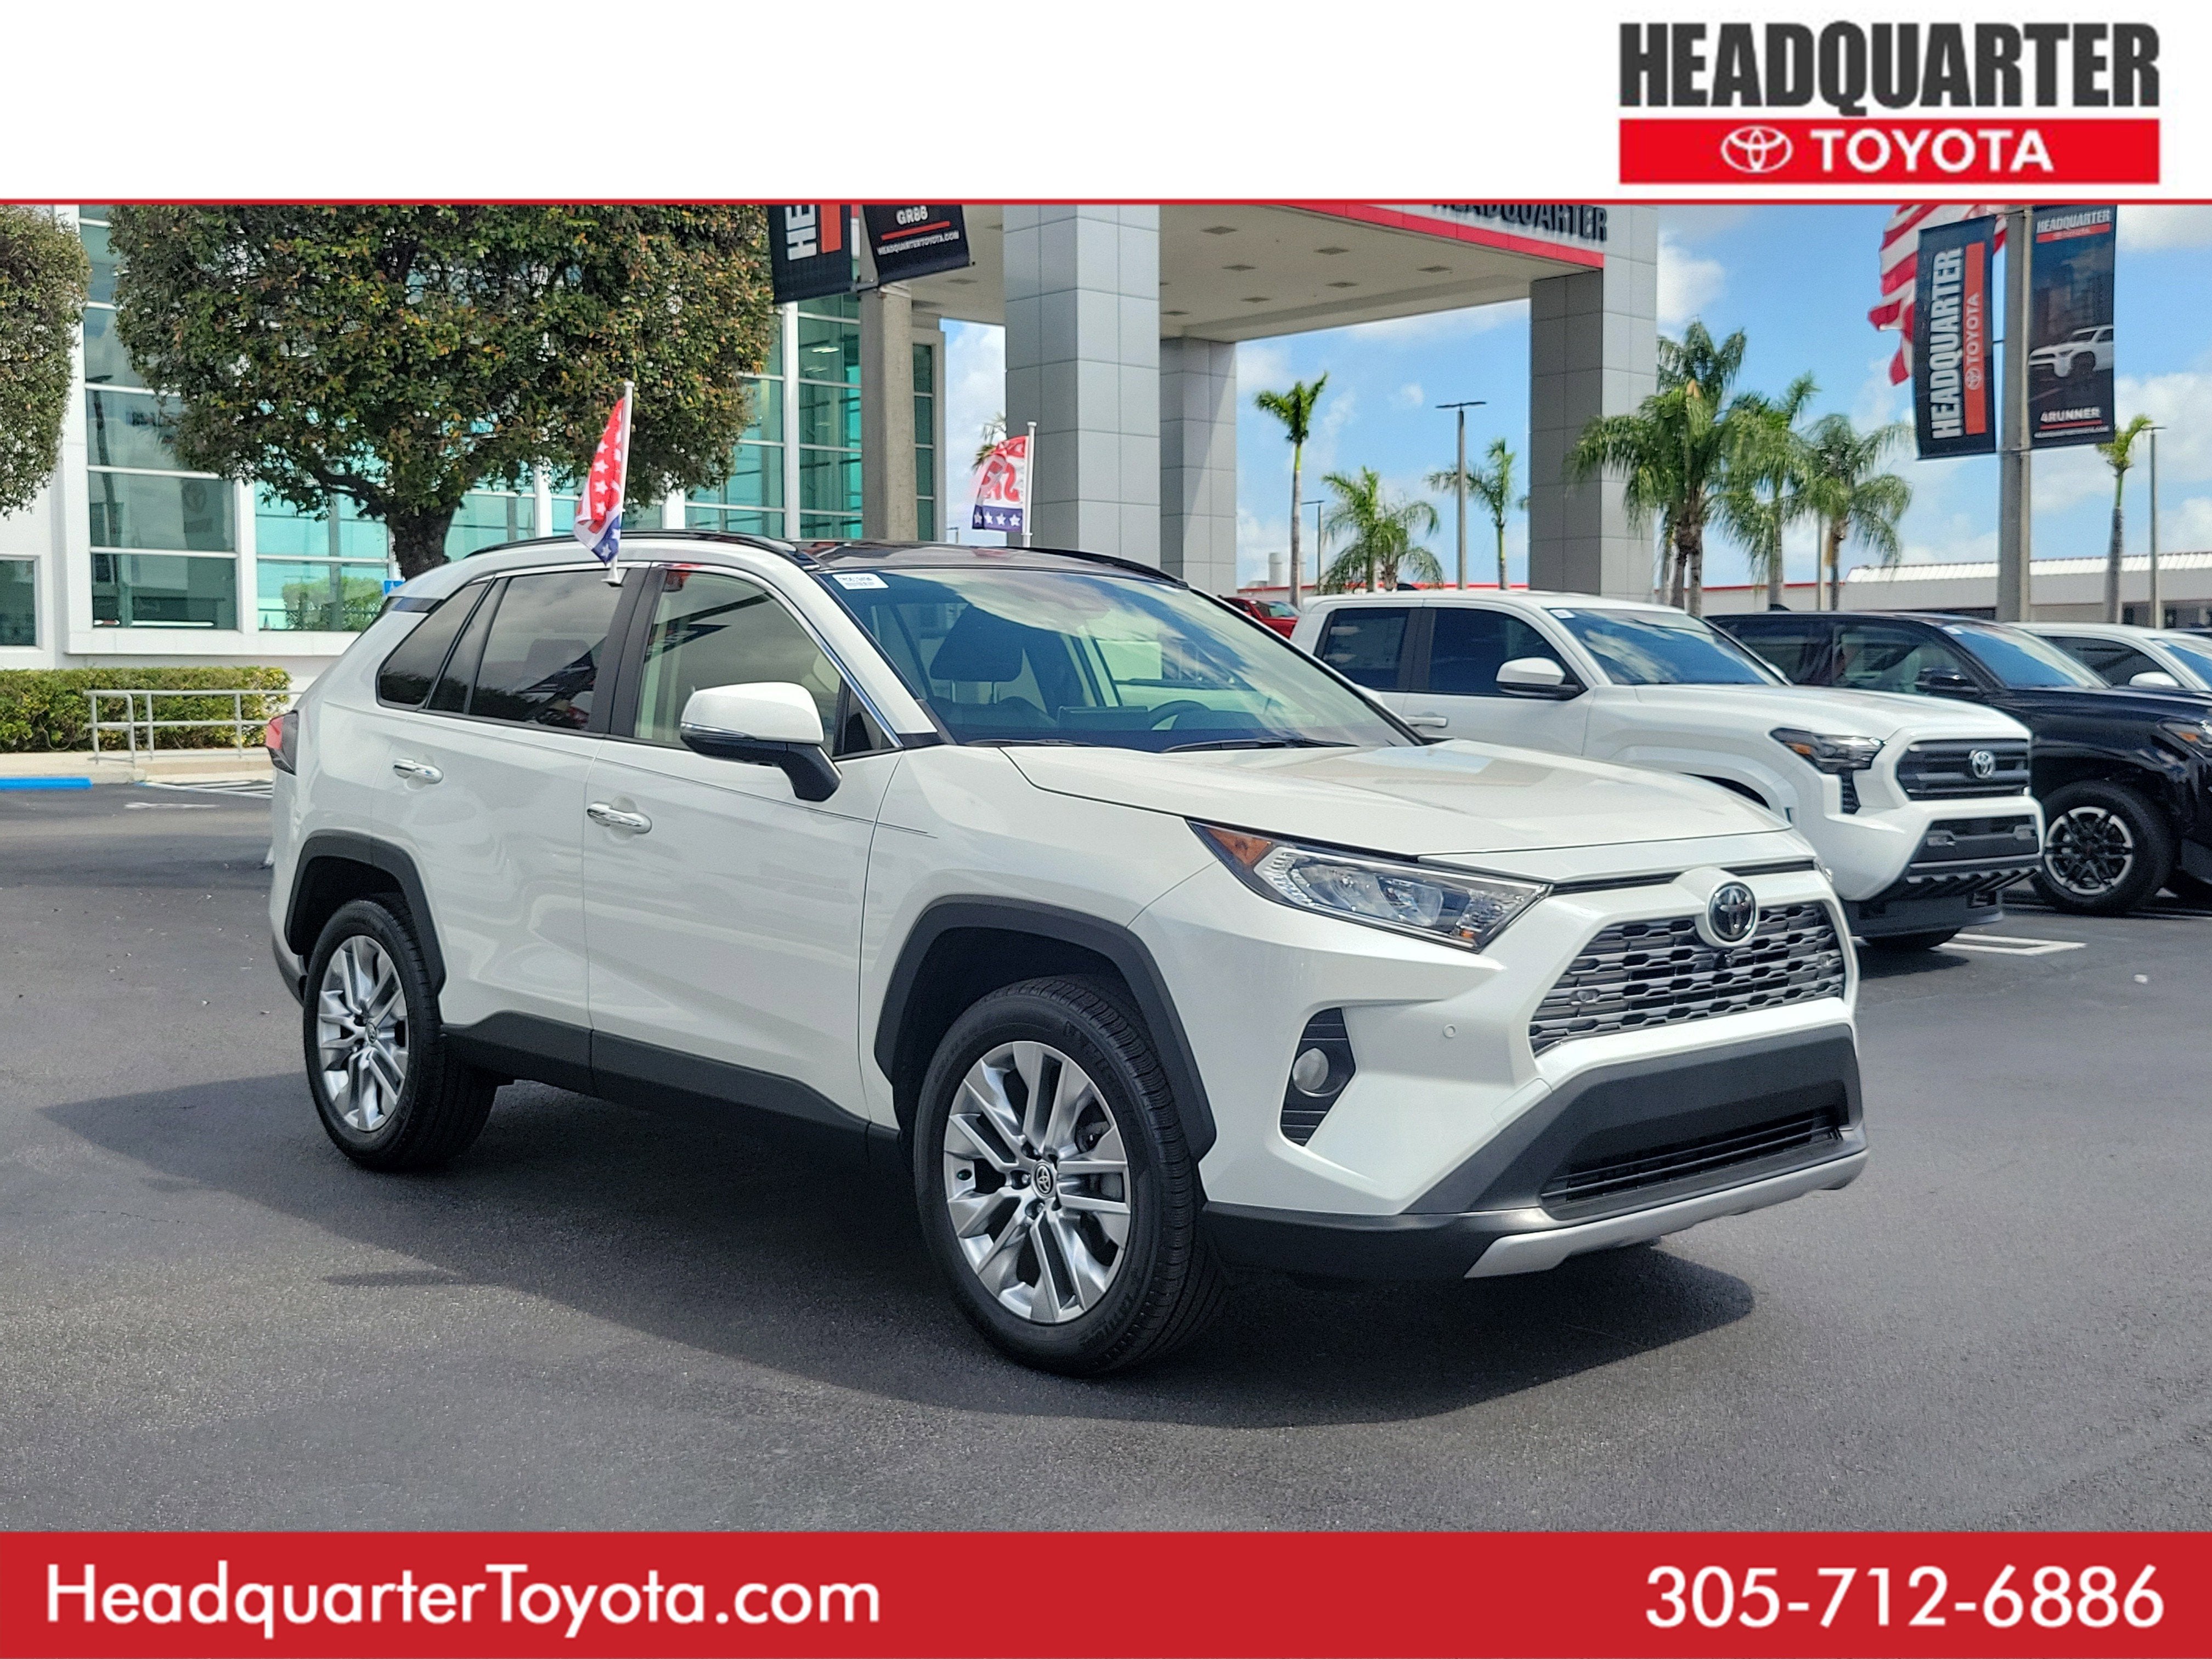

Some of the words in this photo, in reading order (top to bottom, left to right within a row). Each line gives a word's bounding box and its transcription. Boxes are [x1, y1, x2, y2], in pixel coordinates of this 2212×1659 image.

[2036, 209, 2111, 233] HEADQUARTER
[1929, 247, 1963, 438] HEADQUARTER
[1966, 292, 1979, 365] TOYOTA
[2040, 407, 2101, 423] 4RUNNER
